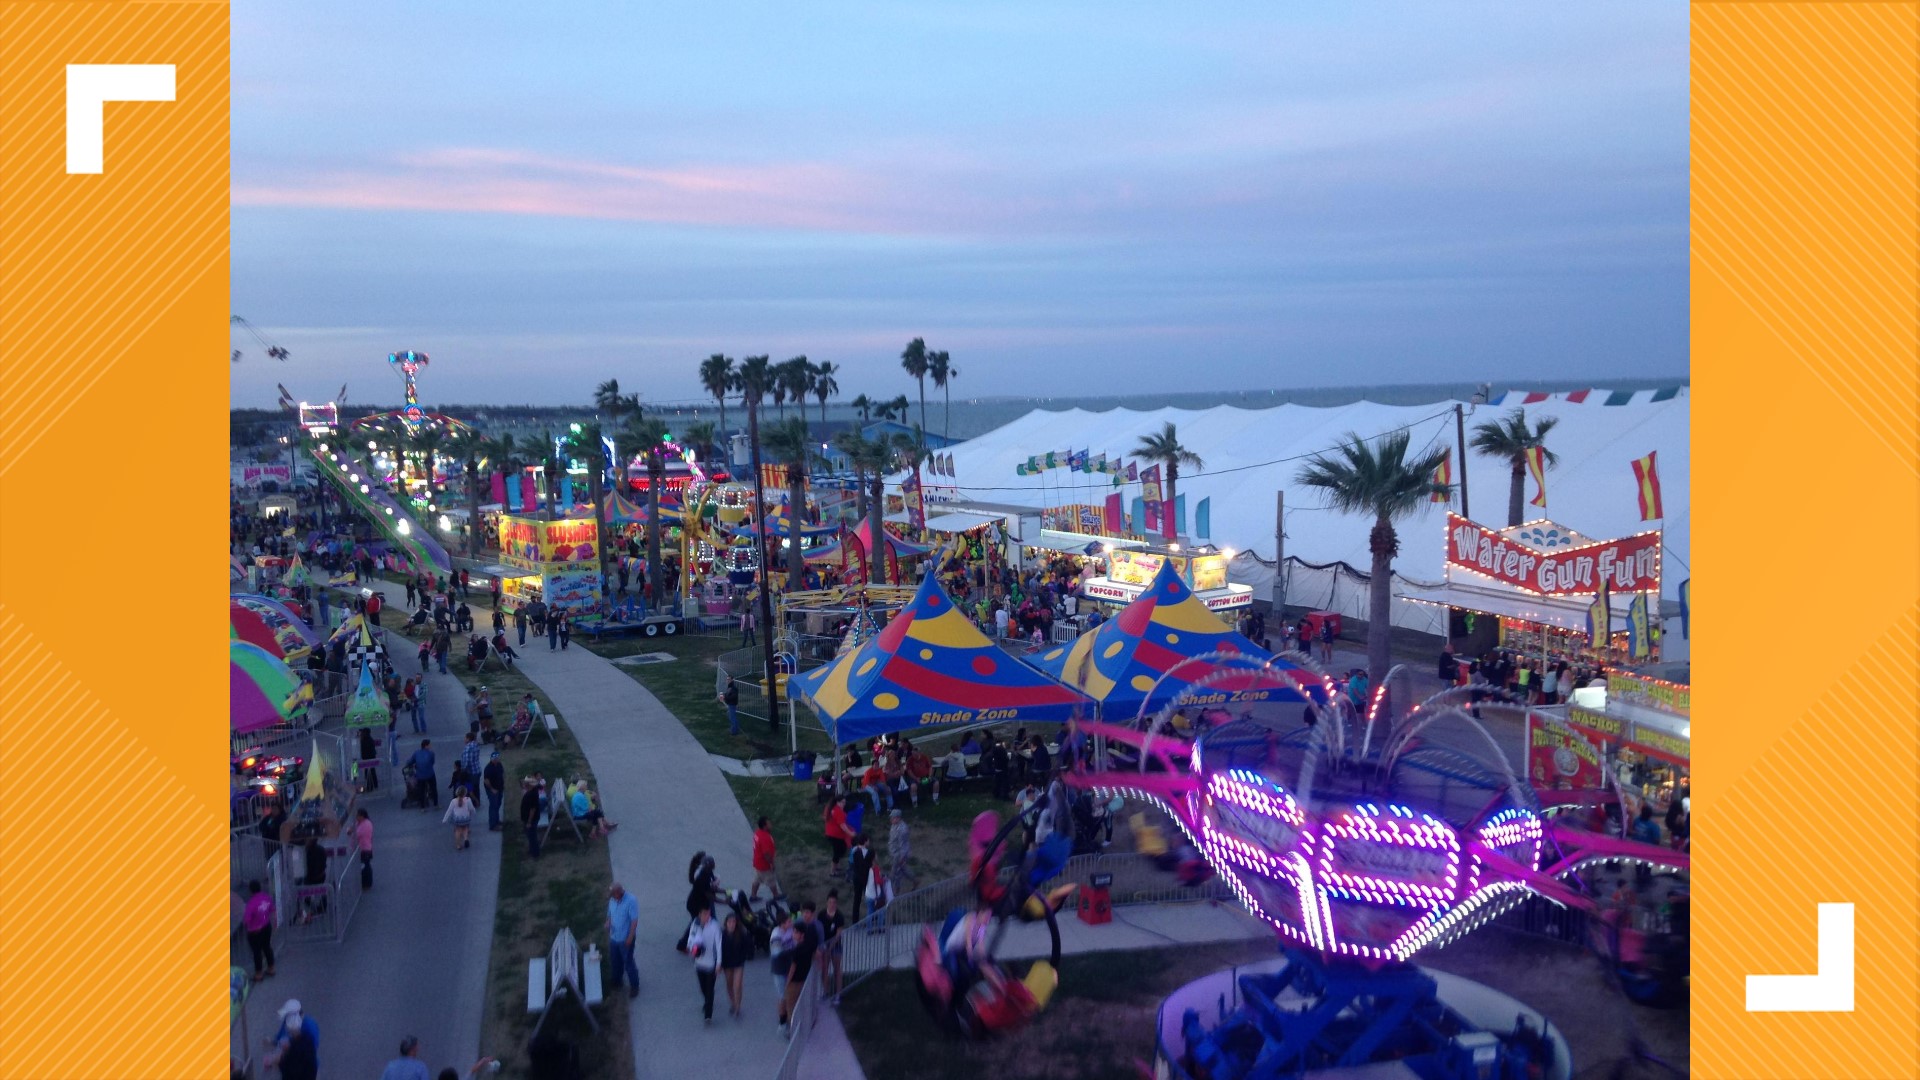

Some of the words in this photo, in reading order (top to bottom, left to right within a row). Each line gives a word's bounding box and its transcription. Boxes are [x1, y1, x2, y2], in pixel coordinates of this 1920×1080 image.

[547, 523, 597, 545] SLUSHIES
[1453, 525, 1536, 581] Water
[1537, 556, 1593, 592] Gun
[1089, 586, 1124, 598] POPCORN
[1208, 598, 1231, 607] COTTON
[1232, 594, 1251, 604] CANDY
[1179, 692, 1227, 706] Shade
[1230, 690, 1270, 702] Zone
[920, 710, 972, 725] Shade
[975, 708, 1018, 721] Zone
